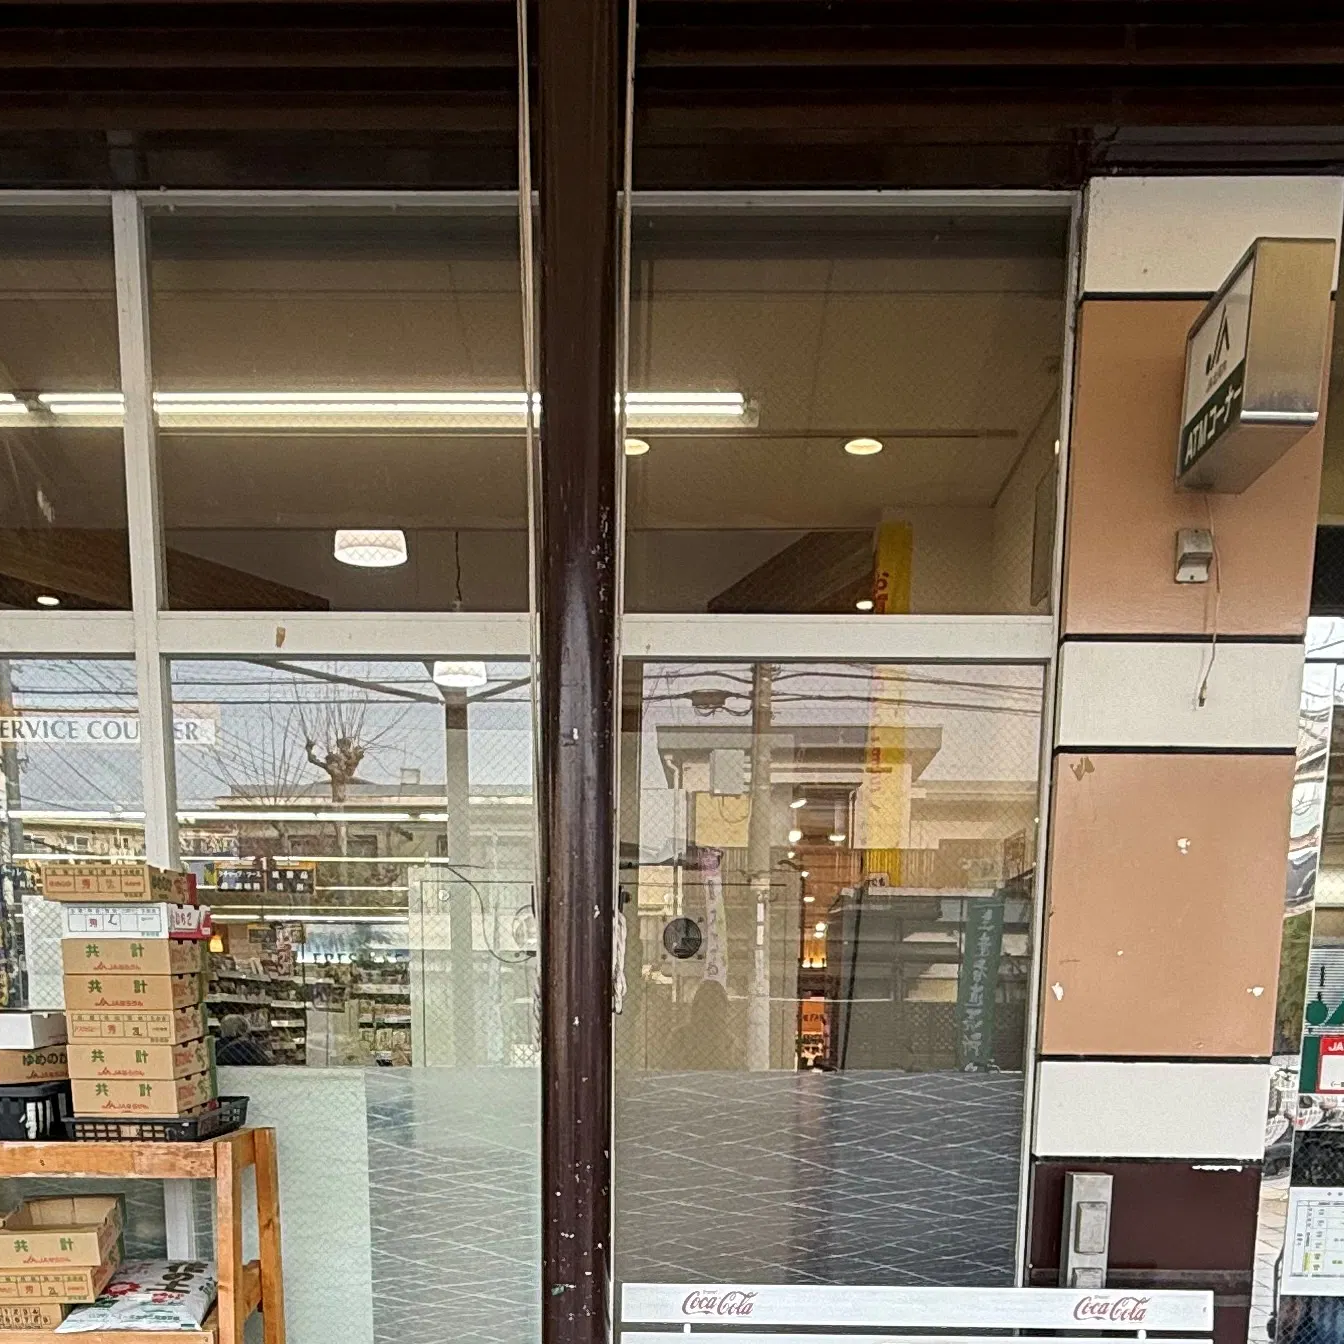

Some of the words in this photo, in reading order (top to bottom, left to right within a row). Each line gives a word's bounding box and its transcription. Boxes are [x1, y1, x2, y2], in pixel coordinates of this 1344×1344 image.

[1184, 383, 1243, 465] ATMコーナー
[86, 719, 200, 741] COUER
